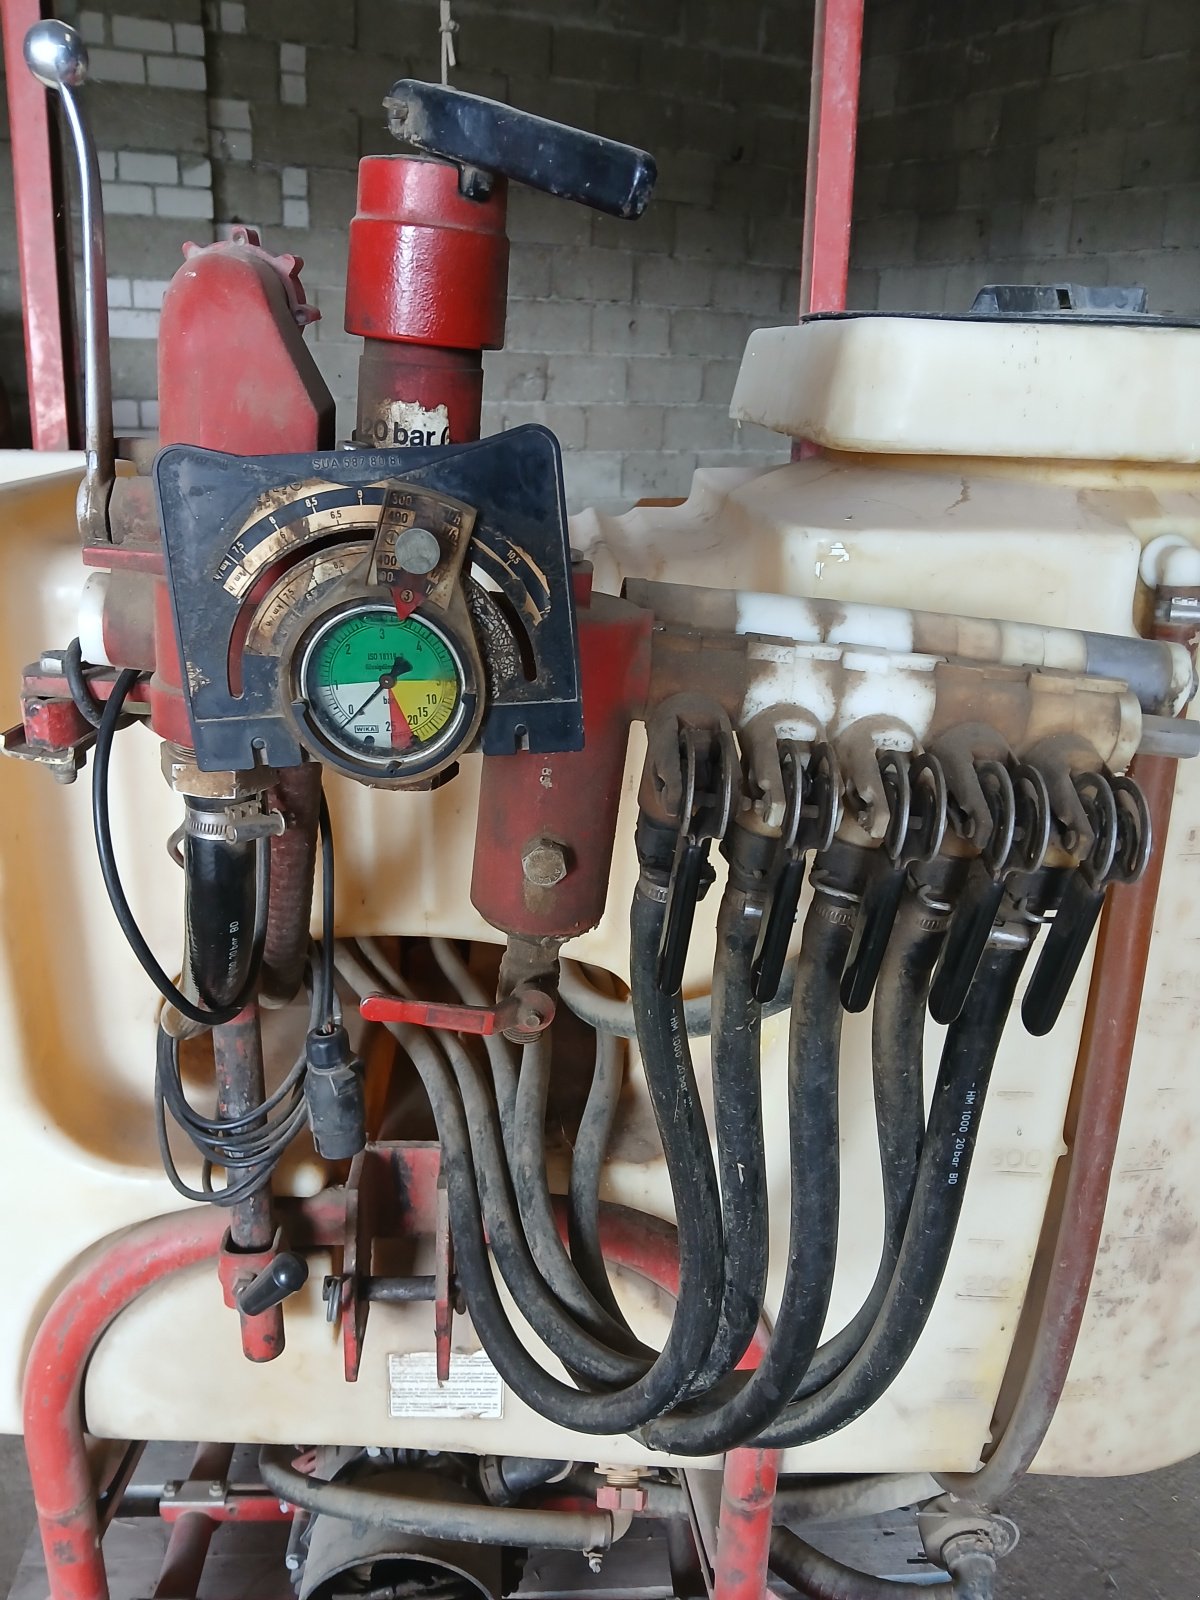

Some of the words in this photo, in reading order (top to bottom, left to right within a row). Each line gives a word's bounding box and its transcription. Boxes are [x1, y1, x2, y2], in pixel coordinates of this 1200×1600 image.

[393, 421, 436, 446] bar
[312, 457, 339, 471] SUA
[357, 489, 363, 499] 9
[268, 516, 276, 524] 8
[279, 531, 286, 539] 6
[379, 629, 385, 640] 3
[345, 643, 351, 655] 2
[416, 641, 422, 652] 4
[367, 653, 378, 661] ISO
[426, 693, 437, 705] 10
[348, 705, 353, 714] 0
[417, 706, 428, 718] 15
[407, 714, 418, 725] 20
[670, 1016, 679, 1032] HM
[964, 1090, 977, 1105] HM
[958, 1110, 972, 1133] 1000
[948, 1172, 959, 1185] BD
